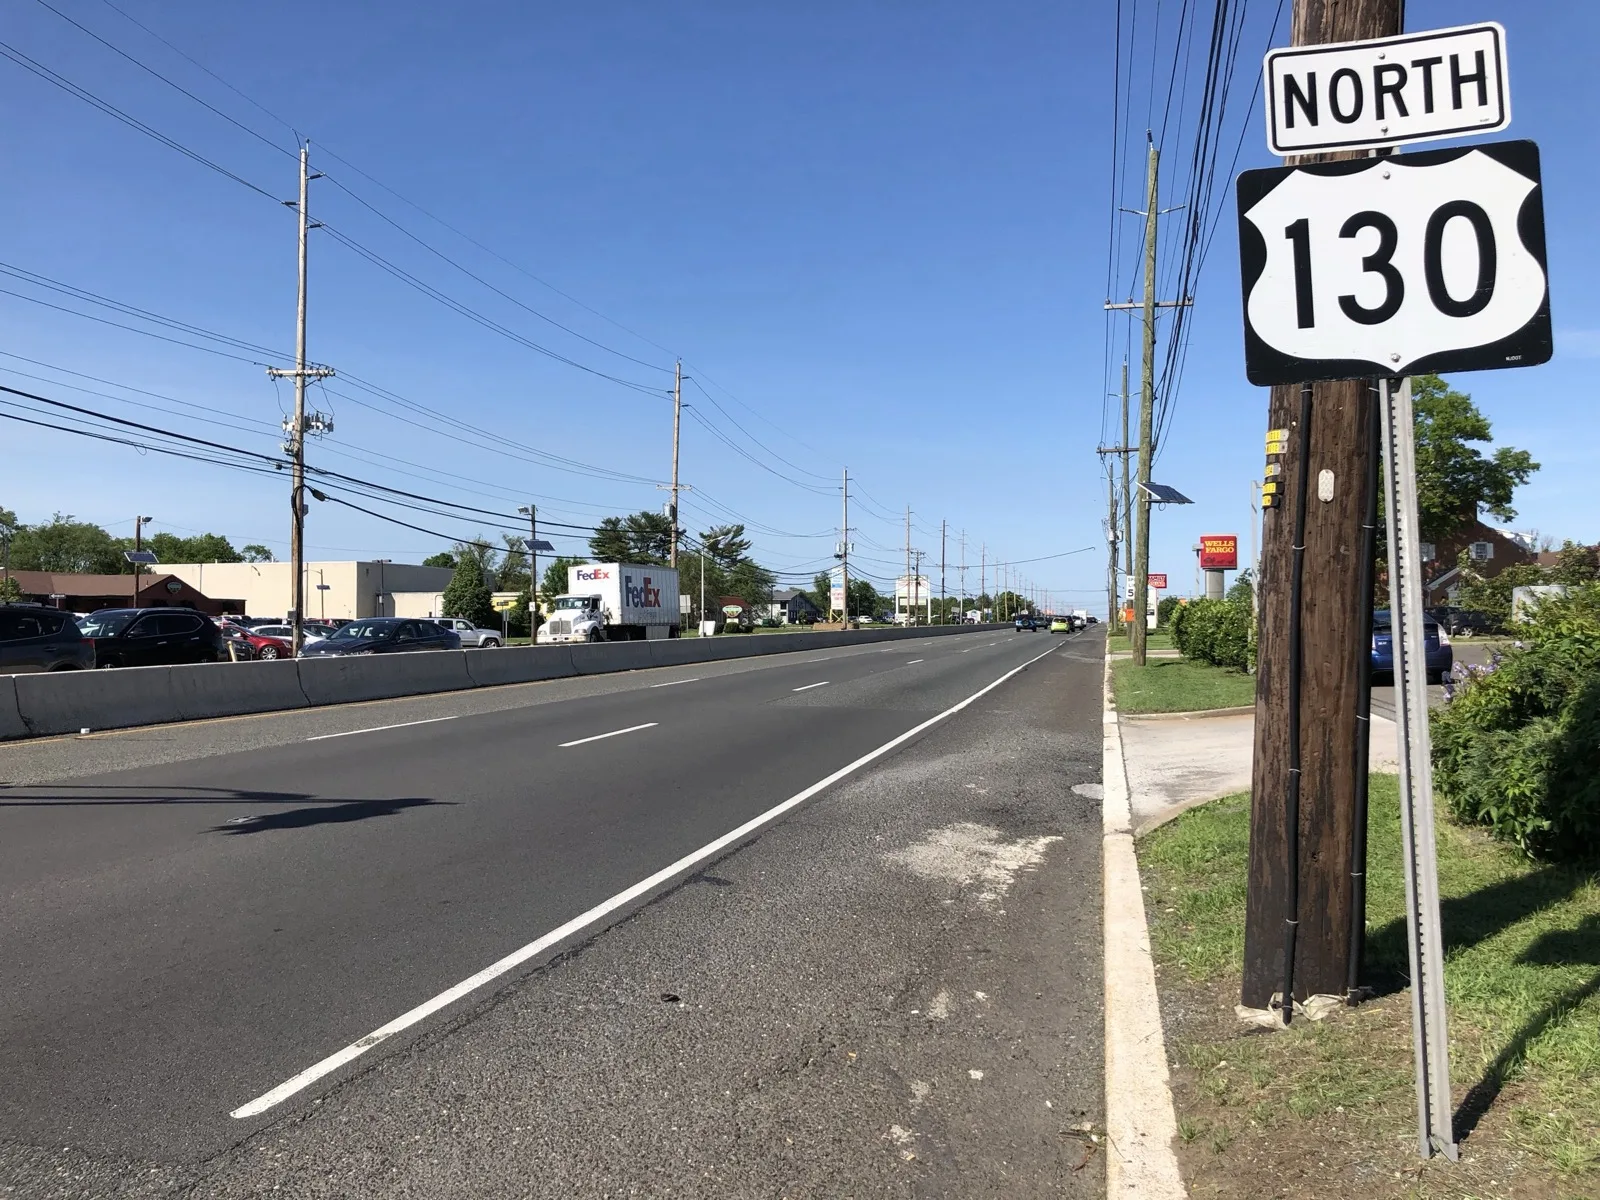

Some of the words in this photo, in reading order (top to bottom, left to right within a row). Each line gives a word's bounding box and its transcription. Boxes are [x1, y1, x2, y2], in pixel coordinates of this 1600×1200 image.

[1283, 49, 1488, 129] NORTH
[1285, 199, 1497, 330] 130
[1205, 546, 1235, 554] FARGO
[576, 568, 610, 580] FedEx
[624, 575, 661, 608] FedEx
